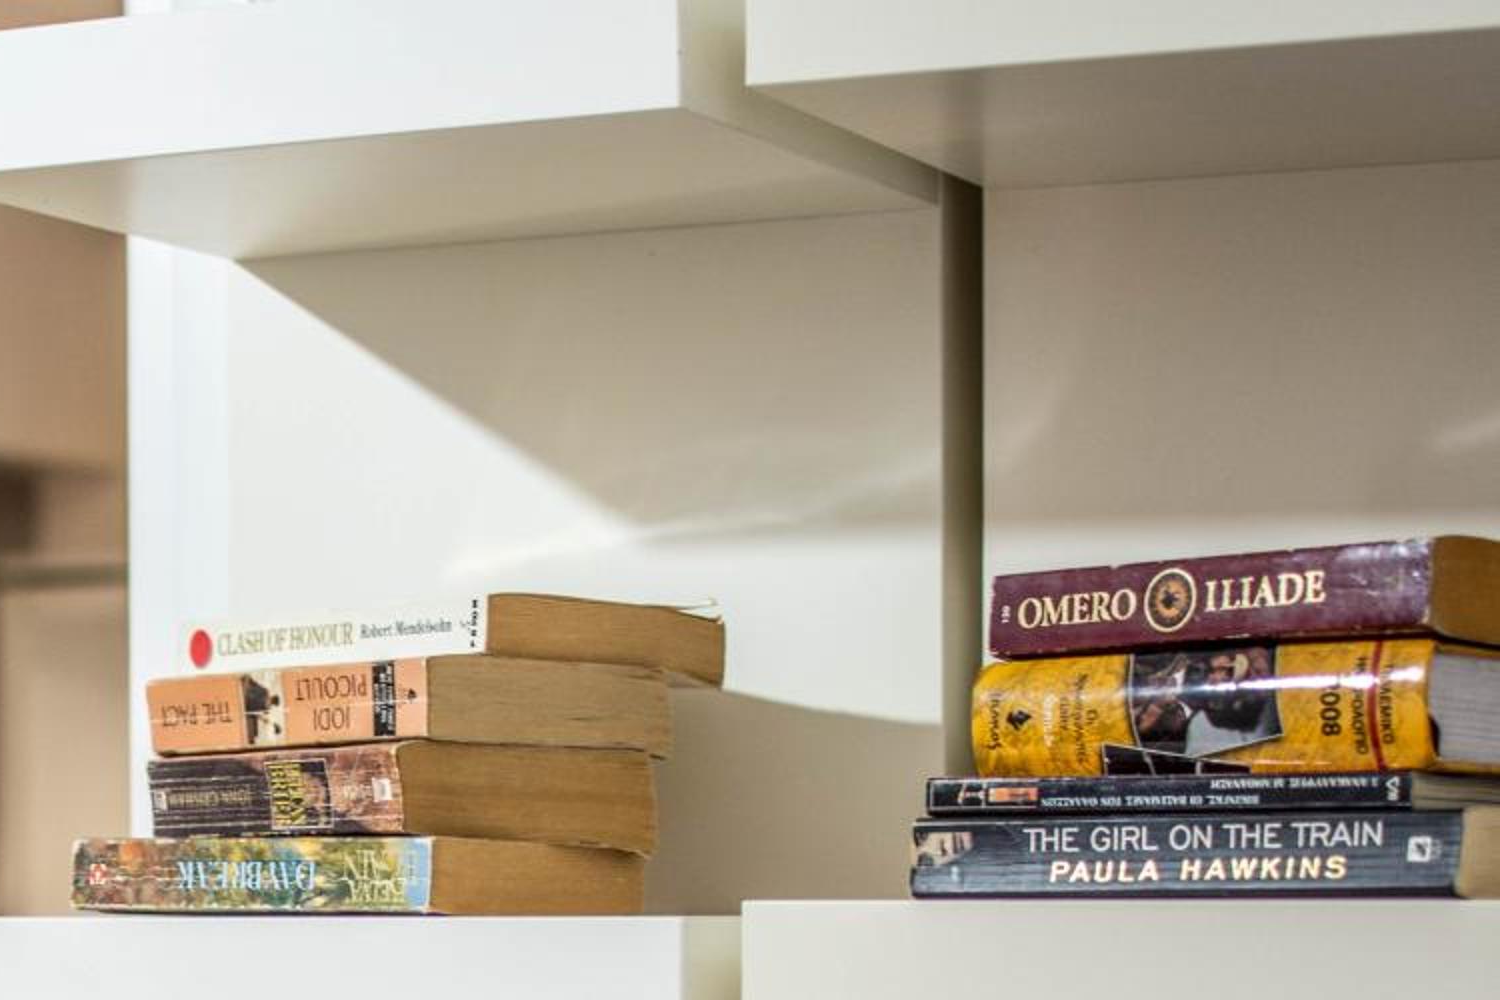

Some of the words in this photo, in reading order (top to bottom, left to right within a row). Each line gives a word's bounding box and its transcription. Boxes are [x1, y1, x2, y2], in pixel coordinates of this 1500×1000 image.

[1016, 587, 1137, 630] OMERO
[1204, 570, 1327, 613] ILIADE
[217, 627, 265, 658] CLASH
[267, 627, 287, 655] OF
[289, 622, 355, 652] HONOUR
[359, 622, 393, 640] Robert
[294, 672, 368, 702] PICOULT
[159, 703, 198, 728] PACT
[202, 701, 233, 725] THE
[311, 705, 351, 733] JODI
[1022, 826, 1080, 855] THE
[1090, 824, 1158, 853] GIRL
[1168, 823, 1215, 851] ON
[1223, 822, 1282, 850] THE
[1290, 820, 1384, 848] TRAIN
[176, 860, 317, 892] DAYBREAK
[1048, 859, 1160, 884] PAULA
[1180, 855, 1348, 882] HAWKINS
